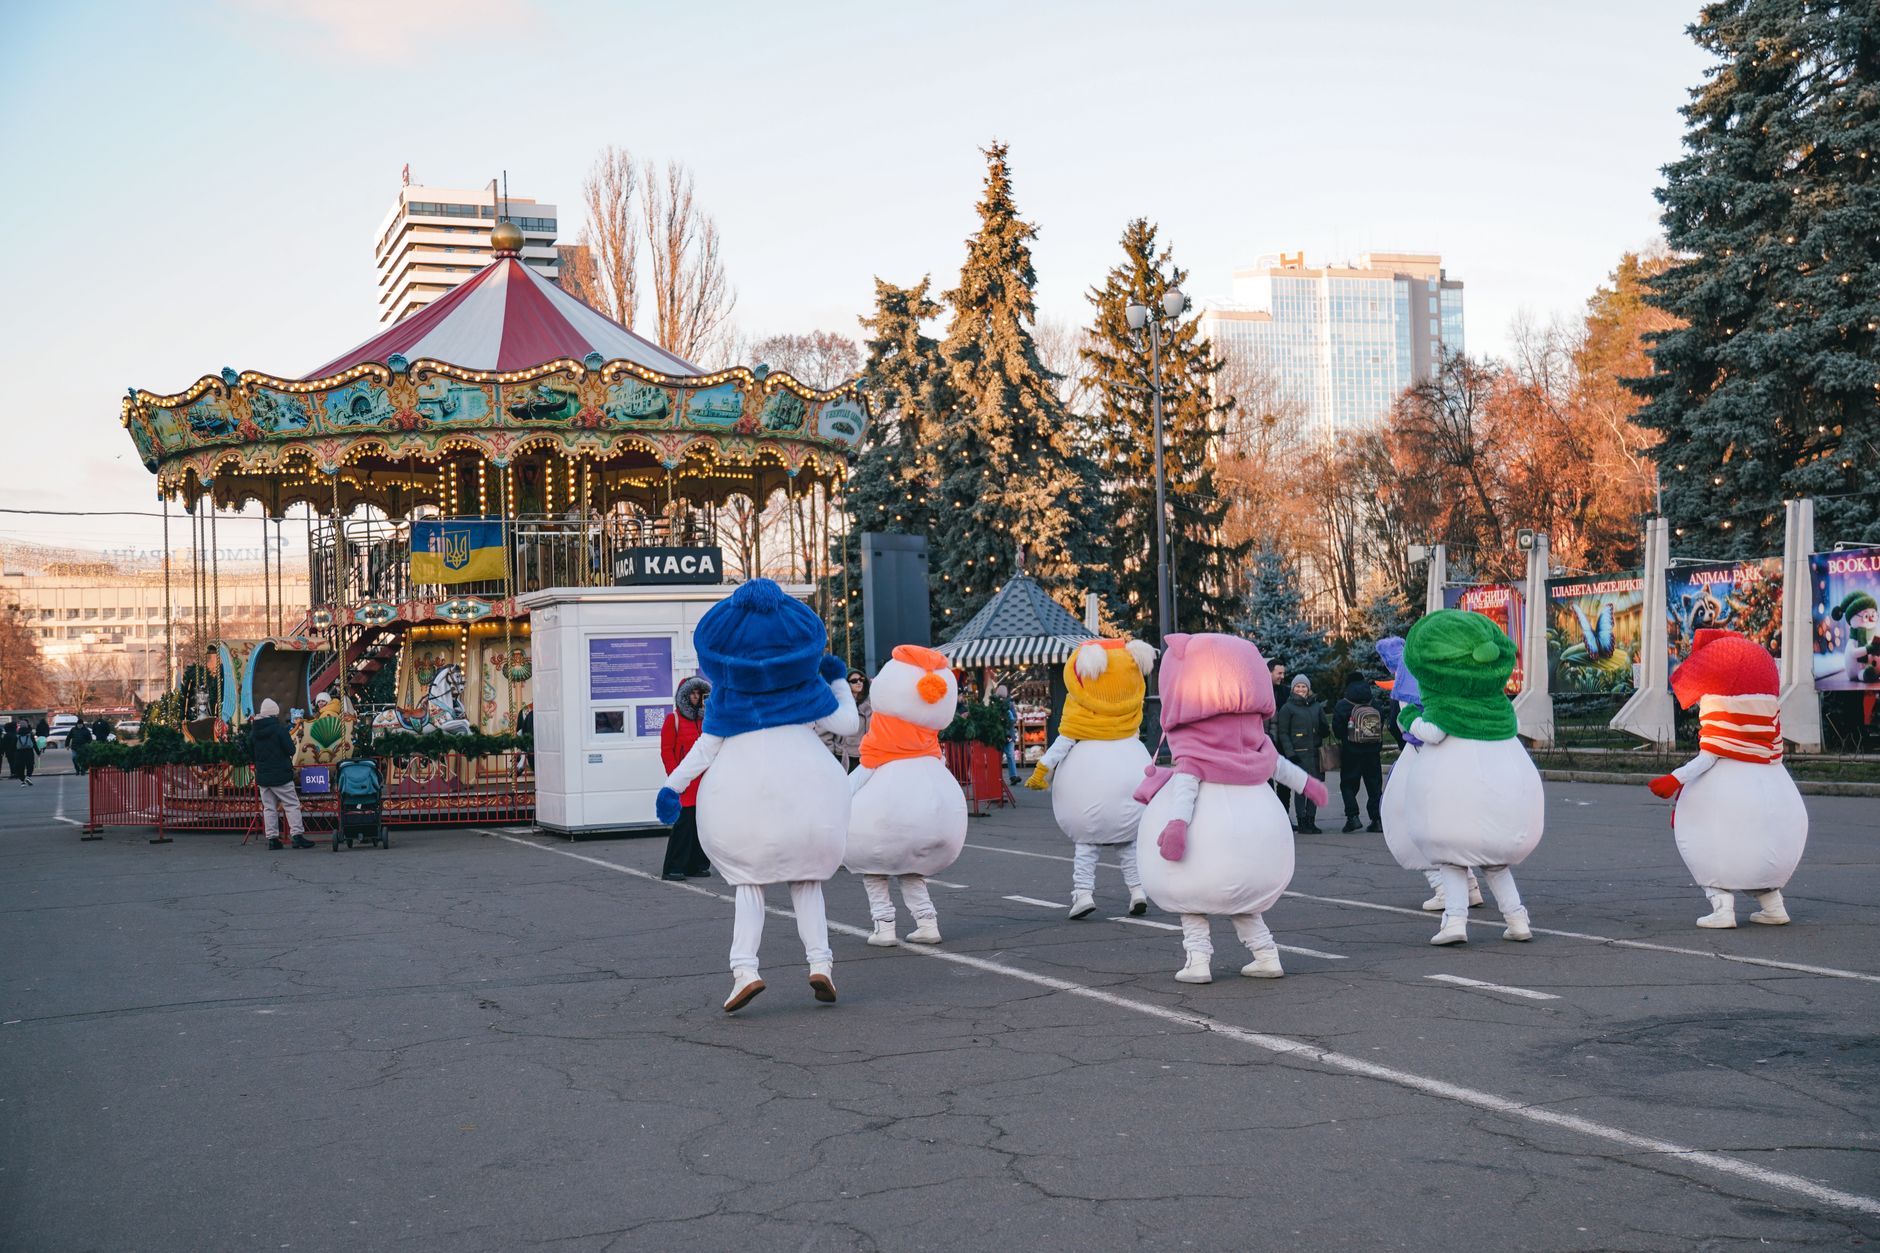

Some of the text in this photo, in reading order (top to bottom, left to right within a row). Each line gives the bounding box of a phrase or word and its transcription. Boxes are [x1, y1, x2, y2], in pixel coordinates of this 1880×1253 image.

[615, 557, 634, 579] КАСА
[644, 555, 715, 574] КАСА
[1689, 567, 1763, 585] ANIMAL PARK
[1466, 589, 1509, 603] МАСНИЦЯ
[1552, 579, 1644, 598] ПЛАНЕТА МЕТЕЛИКІВ
[305, 775, 325, 784] ВХІД
